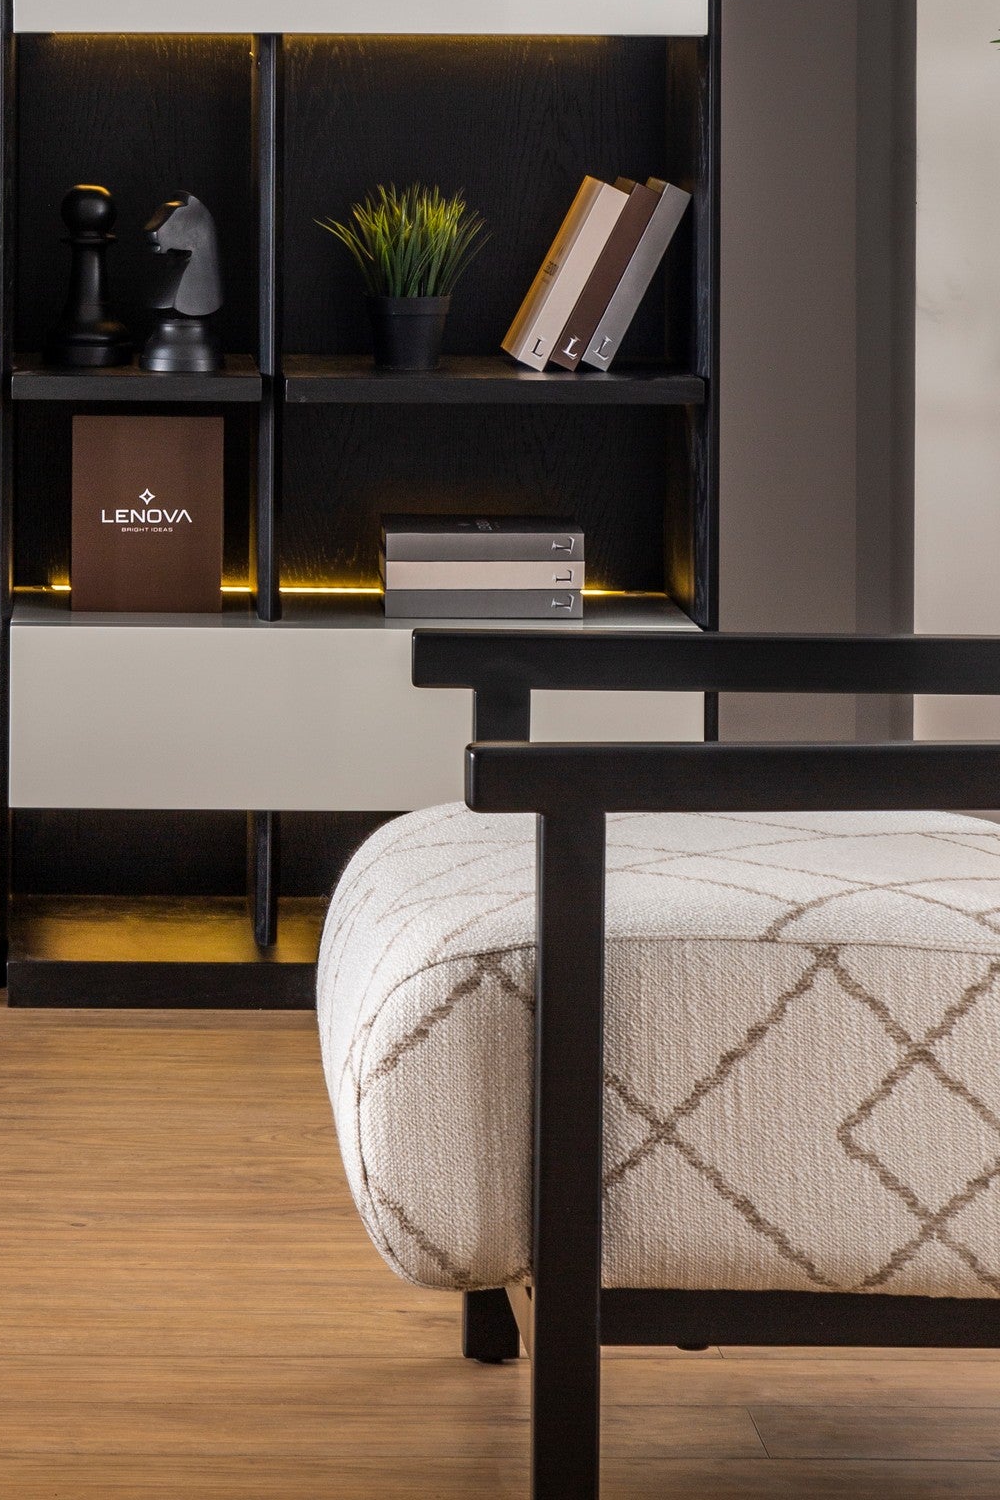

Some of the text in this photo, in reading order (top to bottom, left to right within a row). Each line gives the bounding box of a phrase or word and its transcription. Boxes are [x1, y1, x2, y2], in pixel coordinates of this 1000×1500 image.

[531, 336, 545, 358] L
[562, 334, 581, 360] L
[592, 336, 613, 361] L
[101, 509, 193, 524] LENOVA
[551, 536, 575, 555] L
[554, 569, 573, 583] L
[550, 593, 575, 613] L
